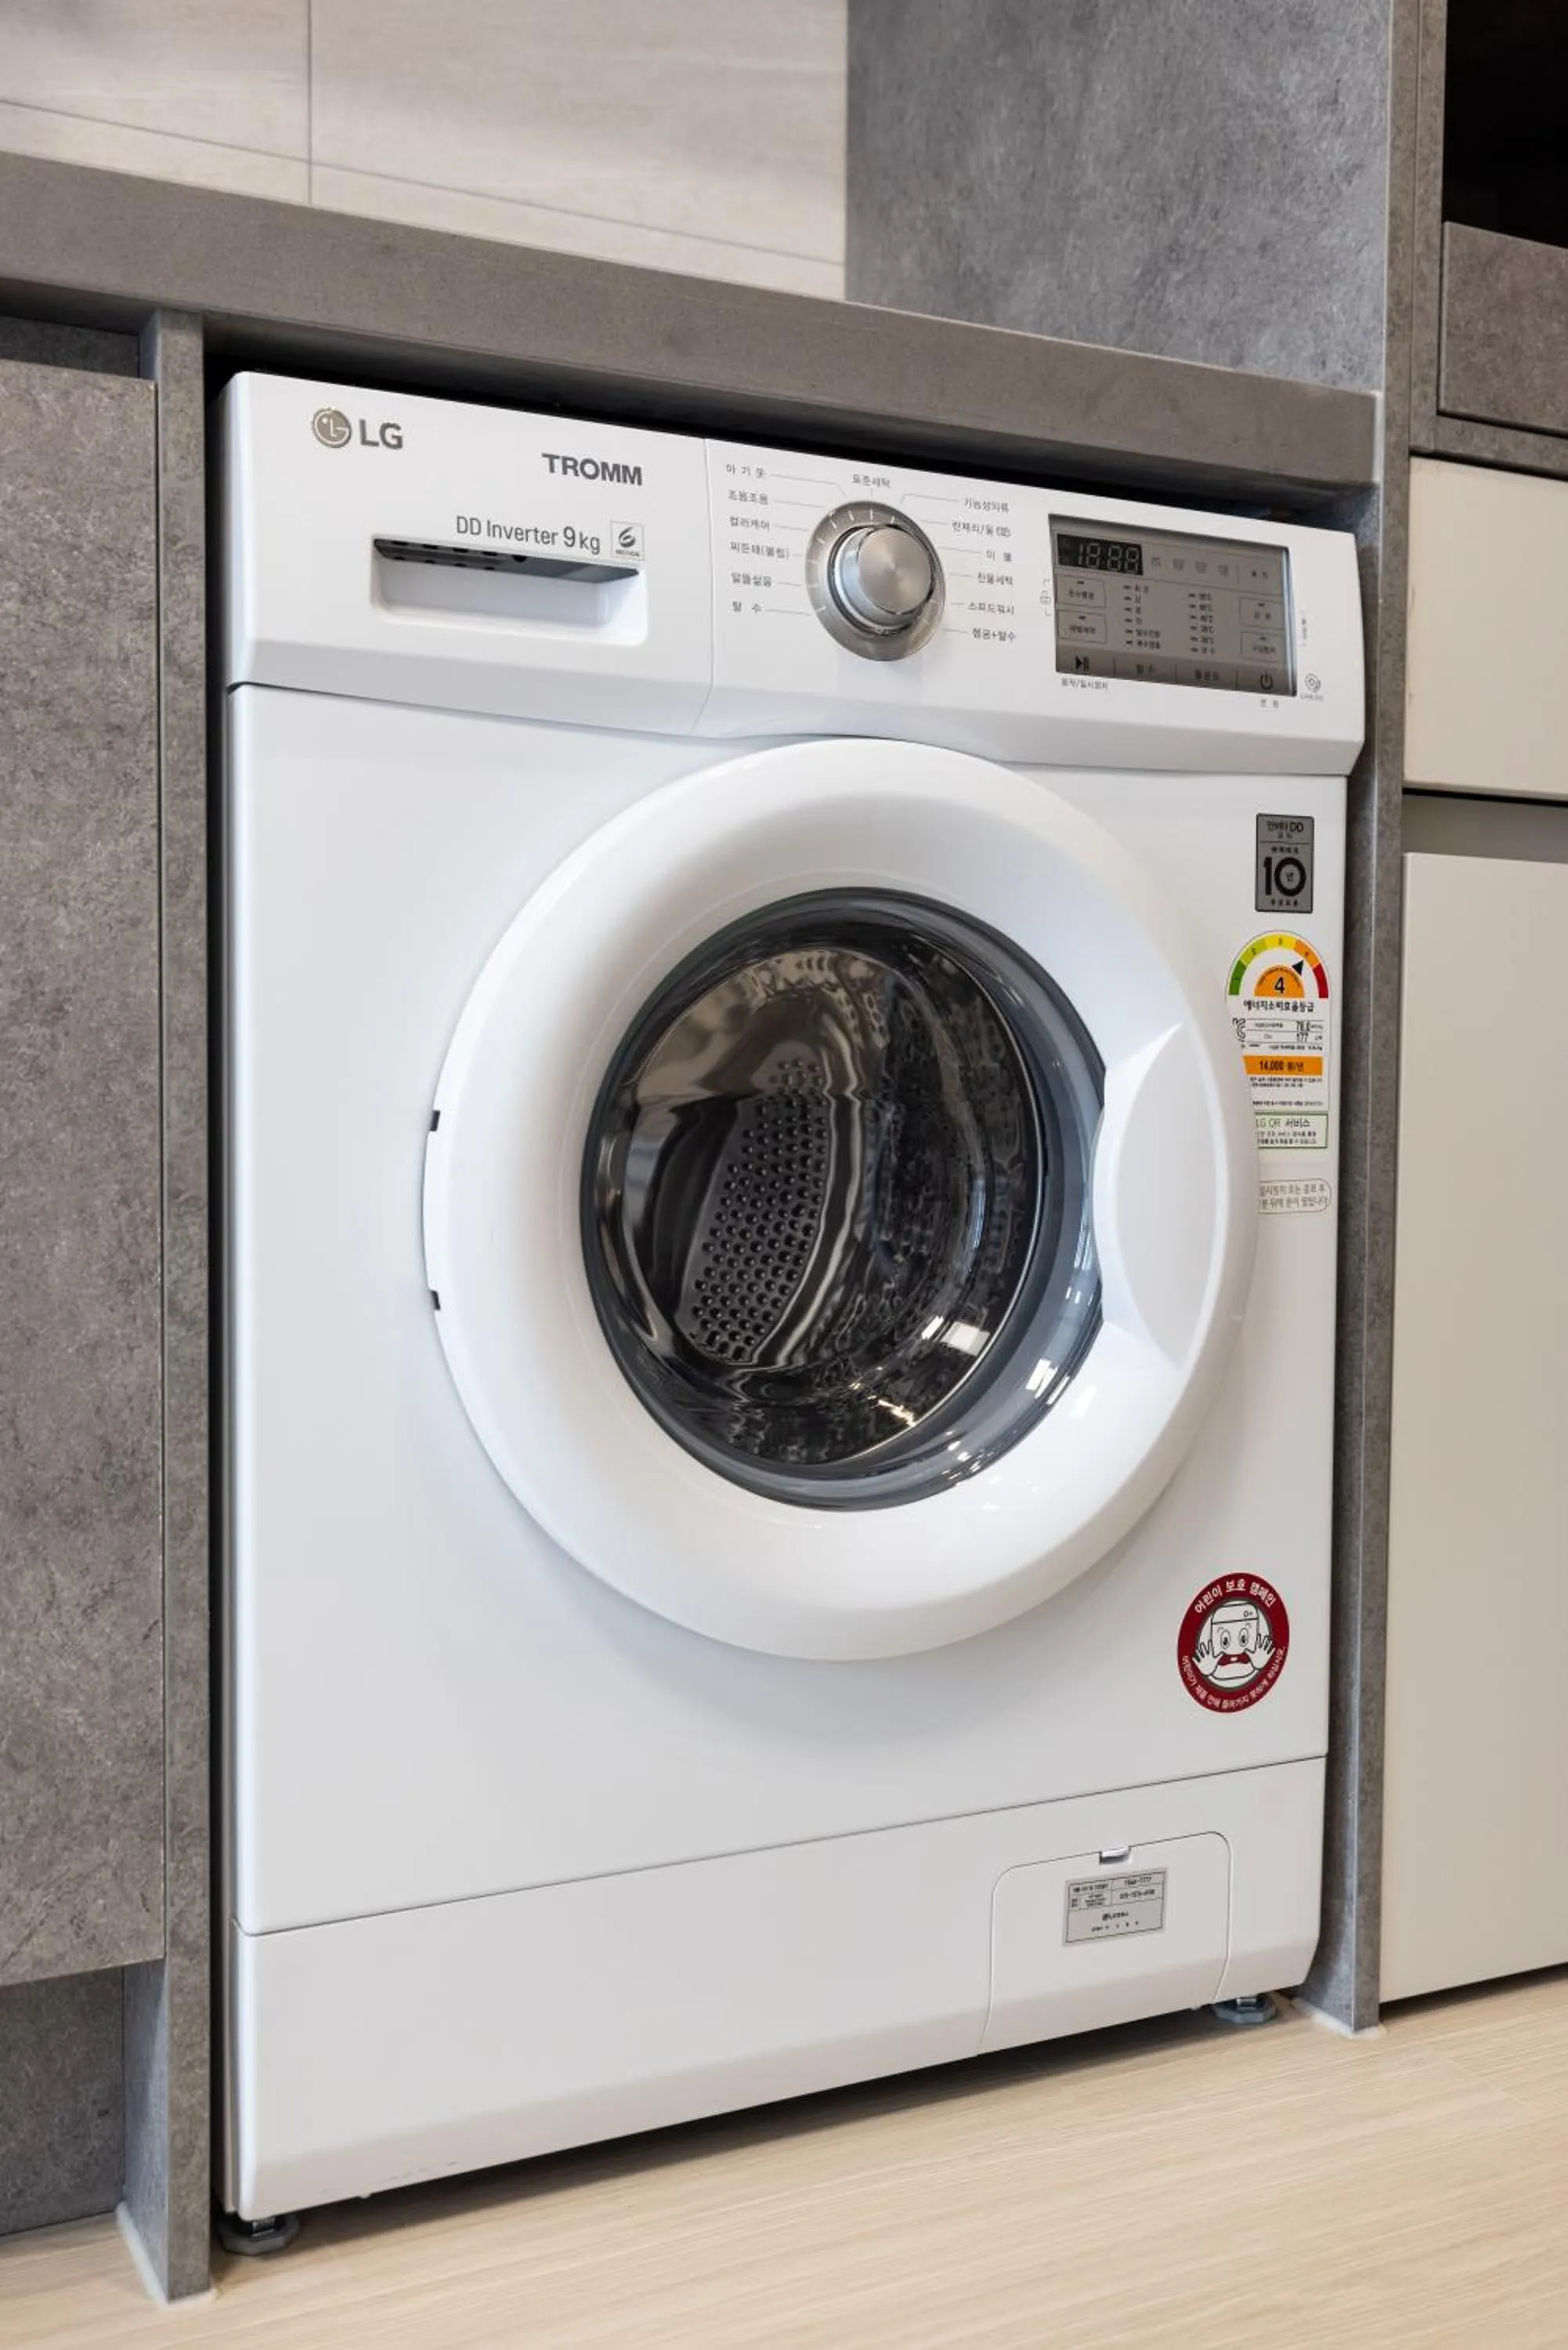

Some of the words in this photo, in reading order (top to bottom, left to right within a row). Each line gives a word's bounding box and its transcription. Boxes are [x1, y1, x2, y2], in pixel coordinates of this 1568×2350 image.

[359, 419, 403, 450] LG
[542, 452, 642, 486] TROMM
[852, 474, 891, 489] 표준세탁
[964, 497, 1009, 513] 기능성의류
[457, 515, 481, 537] DD
[487, 520, 558, 546] Inverter
[977, 572, 1013, 586] 찬물세탁
[968, 602, 1015, 615] 스피드워시
[1061, 678, 1109, 692] 동작/일시정지
[1263, 857, 1306, 897] 10
[1274, 977, 1285, 994] 4
[1244, 1000, 1314, 1013] 에너지소비효율등급
[1285, 1118, 1310, 1129] 서비스
[1194, 1585, 1223, 1614] 어린이
[1225, 1578, 1246, 1593] 보호
[1248, 1581, 1277, 1609] 캠페인
